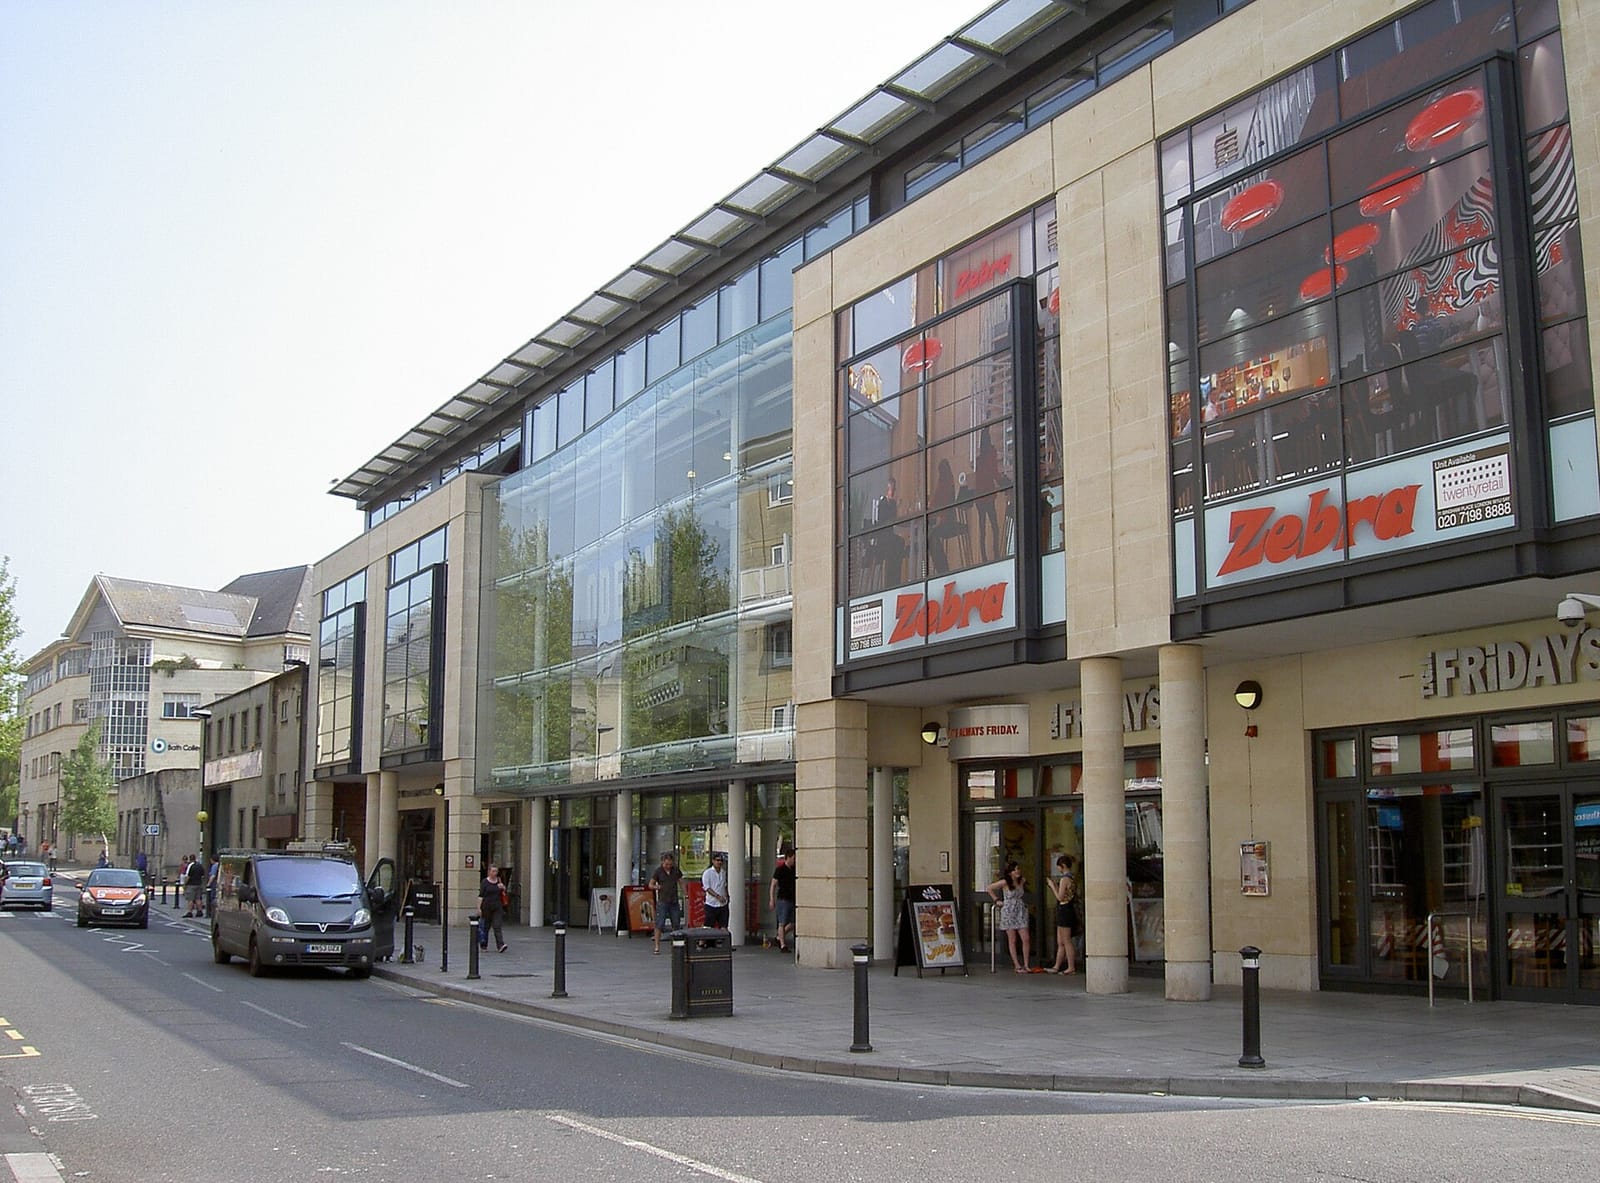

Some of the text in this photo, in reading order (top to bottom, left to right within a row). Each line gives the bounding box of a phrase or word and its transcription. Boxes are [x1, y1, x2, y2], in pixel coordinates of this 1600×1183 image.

[953, 253, 1012, 299] Zebra
[1434, 453, 1476, 469] Unit Available
[1443, 476, 1503, 501] twentyretail
[1438, 502, 1511, 528] 020 7198 8888
[1216, 484, 1423, 577] Zebra
[889, 581, 1009, 644] Zebra
[986, 725, 1019, 736] FRIDAY.
[167, 744, 182, 752] Bath
